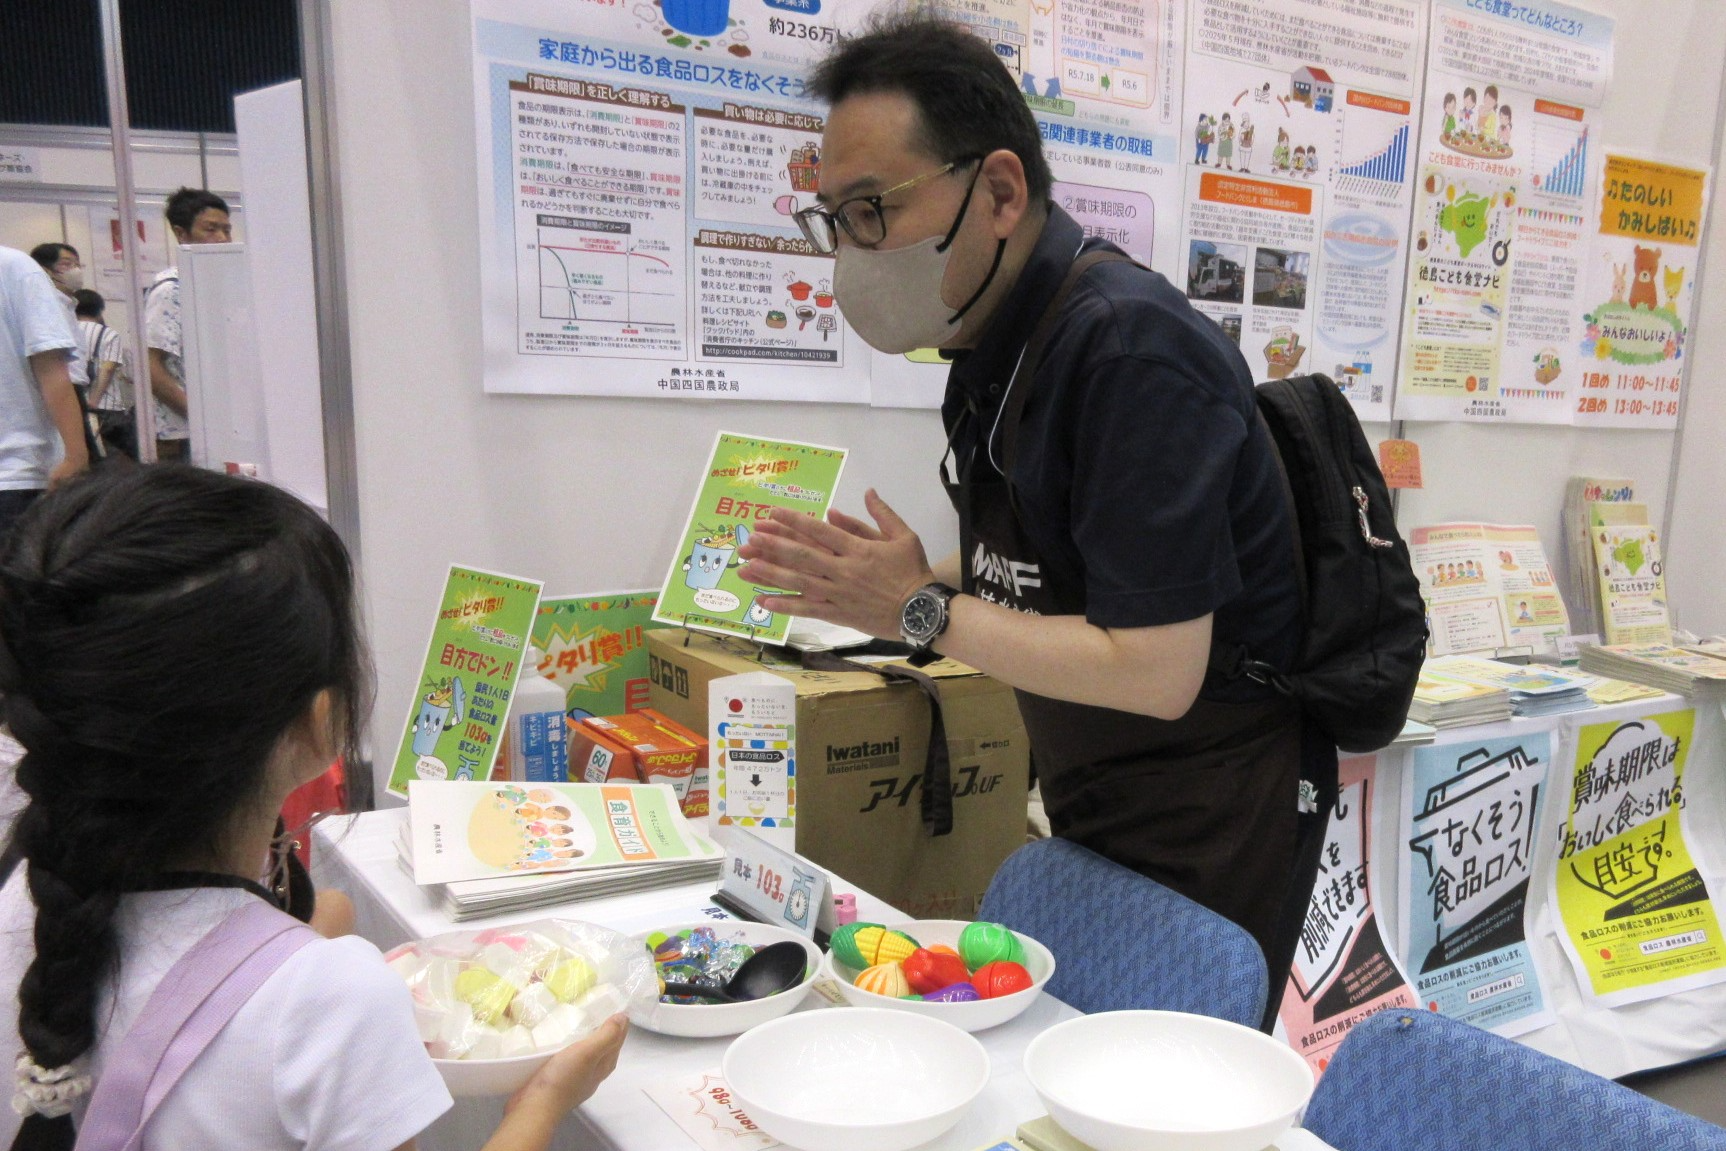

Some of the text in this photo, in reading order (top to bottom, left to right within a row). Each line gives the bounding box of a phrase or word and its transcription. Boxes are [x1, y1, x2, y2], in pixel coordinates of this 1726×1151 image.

[528, 76, 670, 107] 「賞味期限」を正しく理解する
[1419, 264, 1500, 289] 徳島こども食堂ナビ
[657, 378, 740, 392] 中国四国農政局
[671, 368, 726, 378] 農林水産省
[731, 751, 780, 760] 日本の食品ロス
[827, 737, 900, 762] Iwatani
[1572, 736, 1681, 814] 賞味期限は
[1441, 789, 1524, 857] なくそう
[1594, 820, 1673, 892] 目安です。
[1580, 907, 1705, 941] 食品ロスの削減にご協力お願いします。
[1417, 949, 1522, 991] 食品ロスの削減にご協力お願いします。
